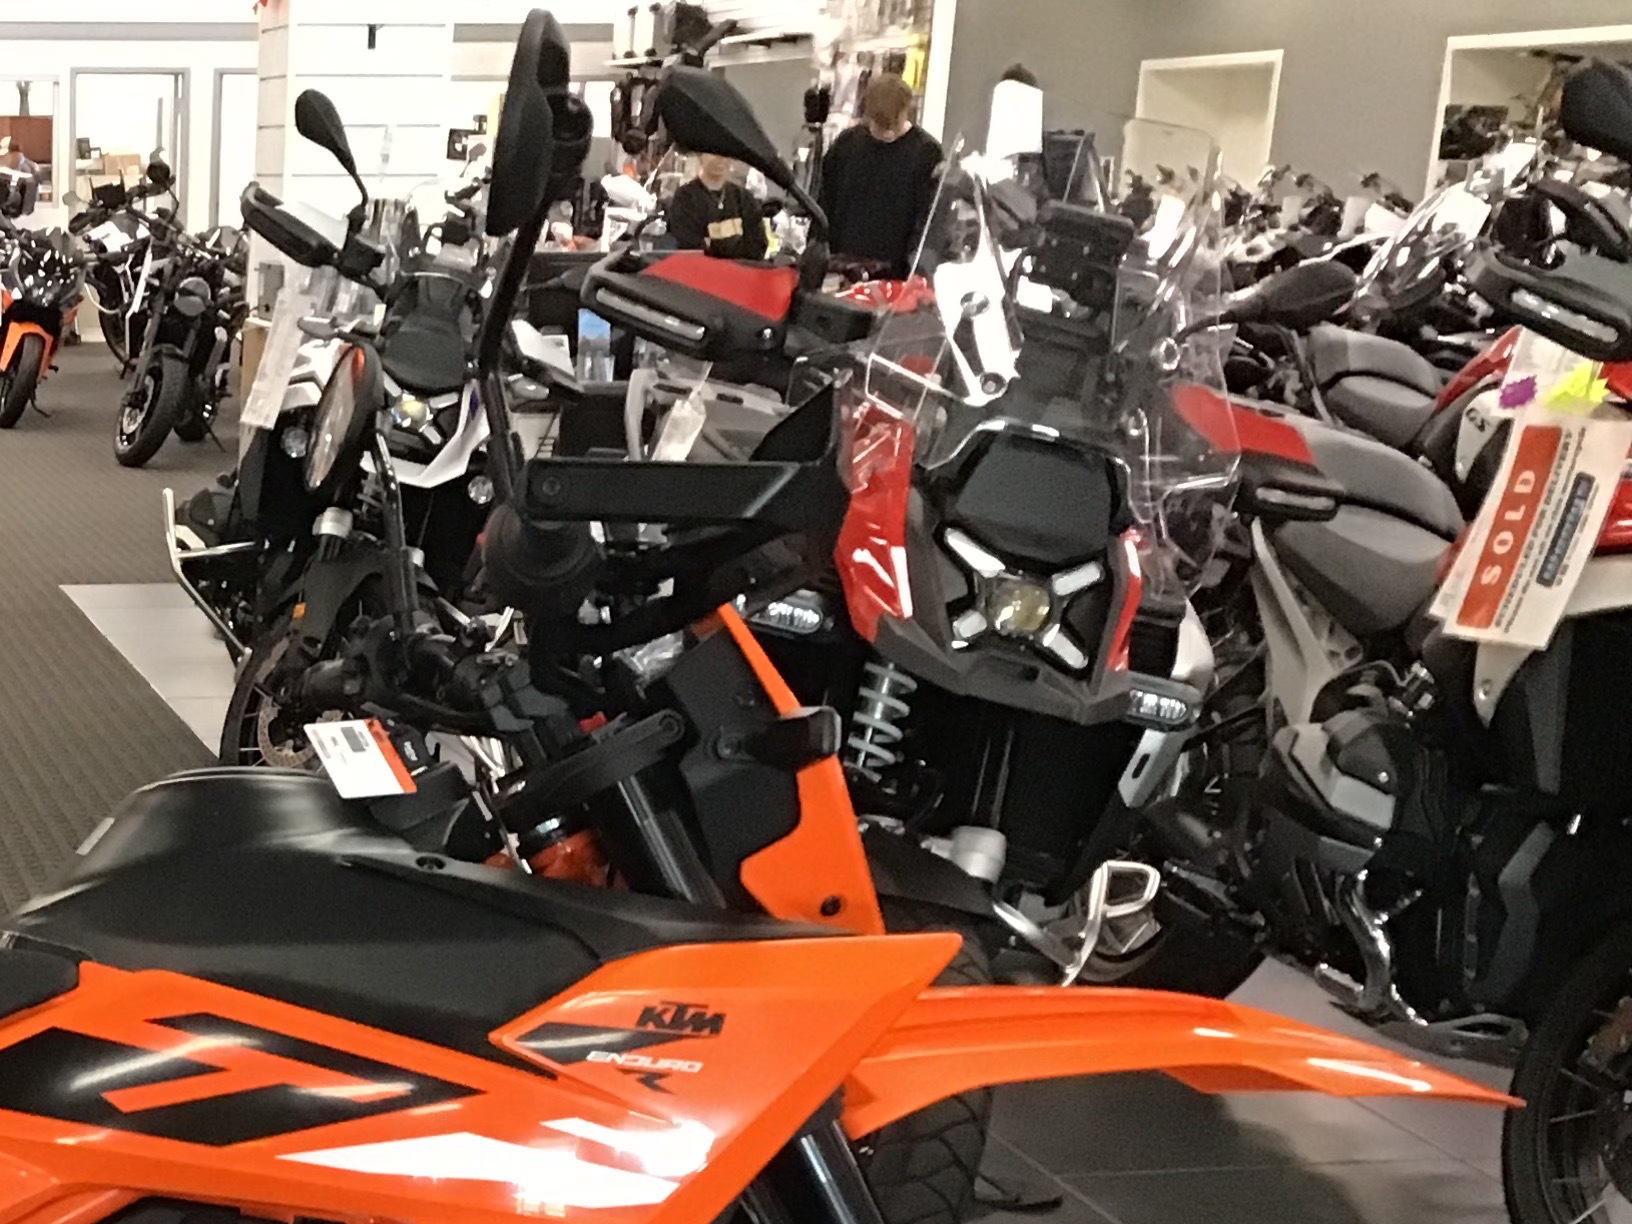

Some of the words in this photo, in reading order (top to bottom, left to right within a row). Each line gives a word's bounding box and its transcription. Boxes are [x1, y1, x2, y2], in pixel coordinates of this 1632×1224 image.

[1479, 470, 1536, 586] SOLD
[635, 1000, 727, 1035] KTM
[586, 1050, 704, 1073] ENDURO
